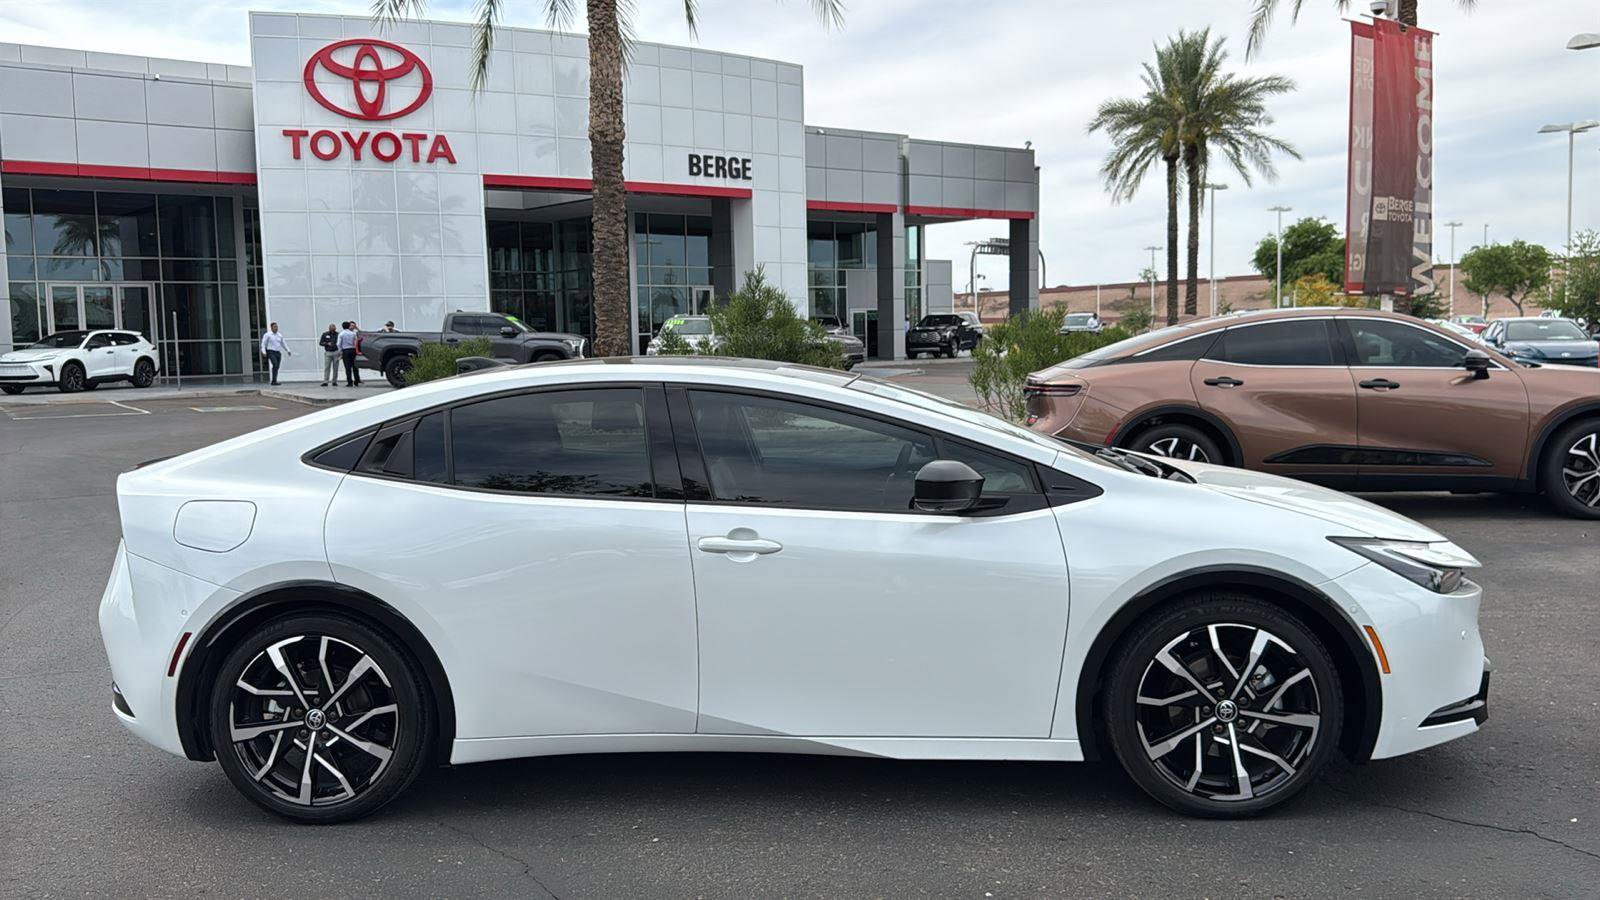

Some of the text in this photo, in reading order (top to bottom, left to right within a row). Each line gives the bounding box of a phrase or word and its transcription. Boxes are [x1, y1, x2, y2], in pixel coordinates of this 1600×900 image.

[282, 129, 457, 164] TOYOTA
[688, 153, 752, 180] BERGE
[1411, 34, 1434, 296] WELCOME
[1388, 196, 1413, 212] BERGE
[1388, 212, 1412, 222] TOYOTA
